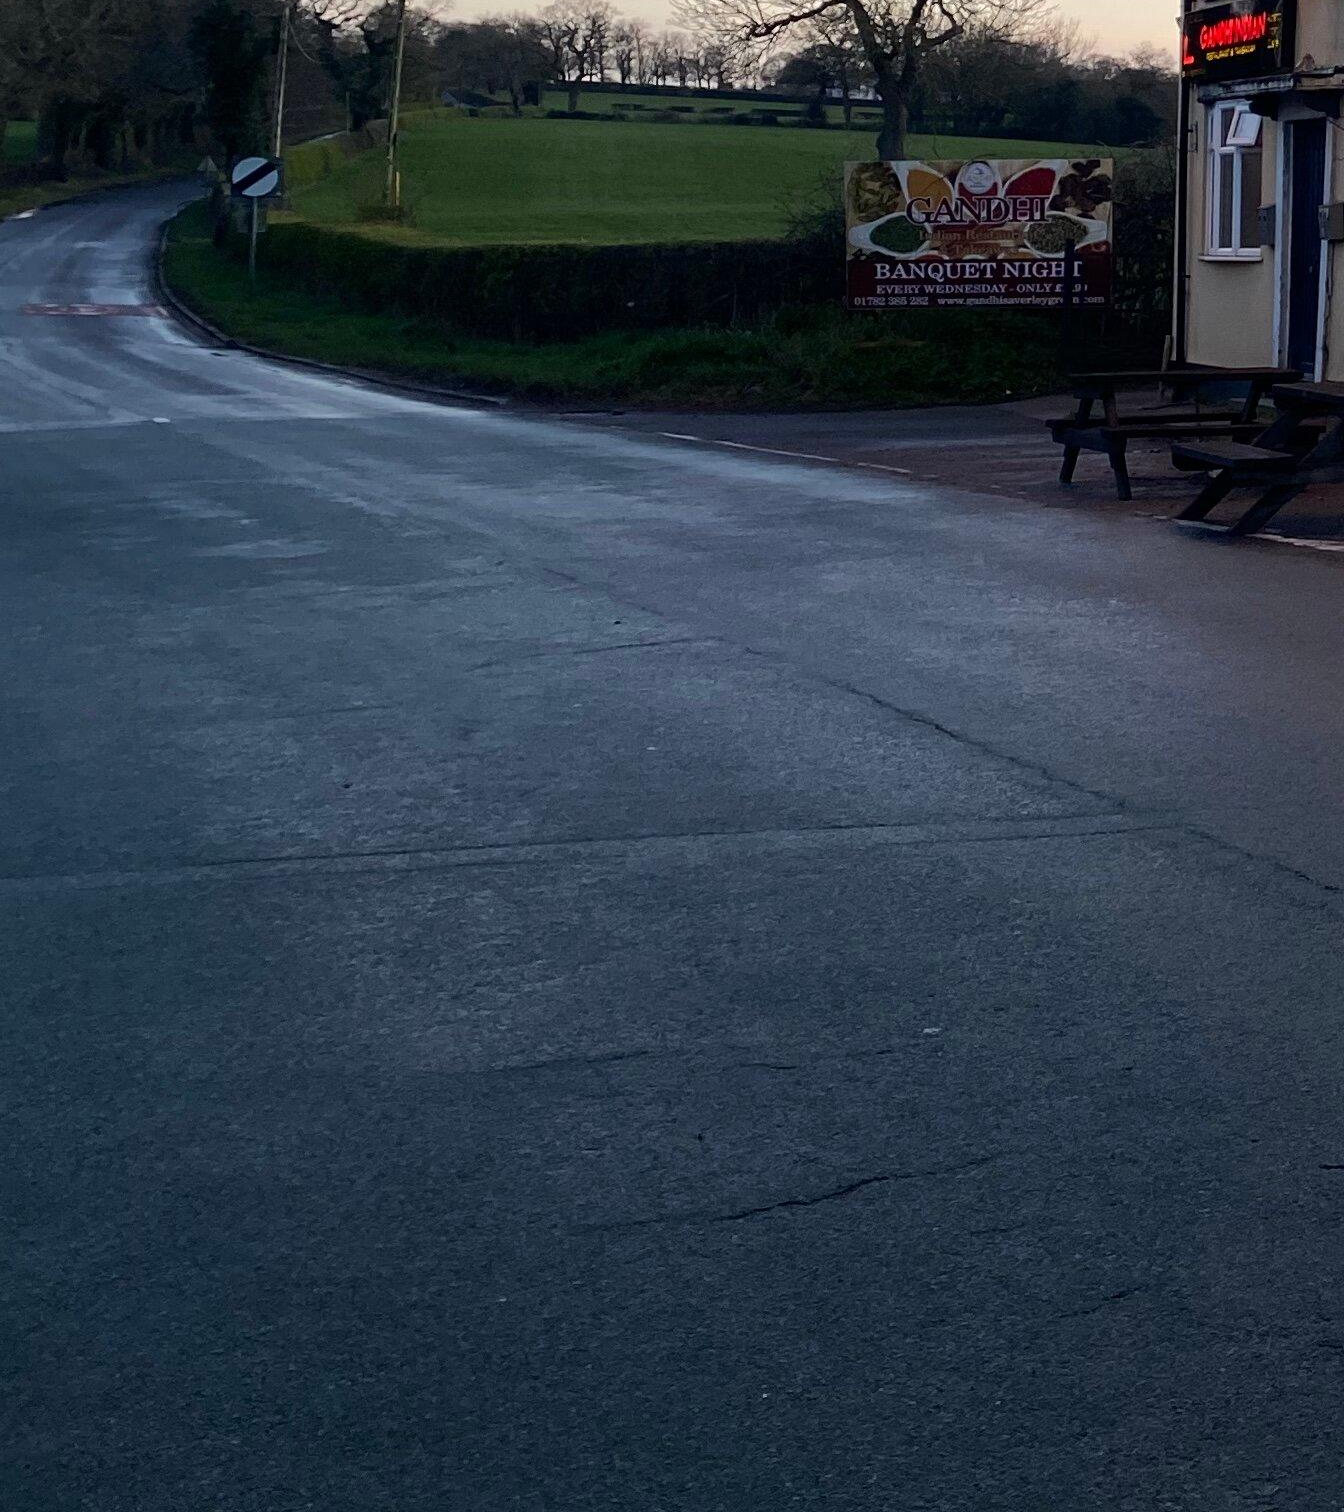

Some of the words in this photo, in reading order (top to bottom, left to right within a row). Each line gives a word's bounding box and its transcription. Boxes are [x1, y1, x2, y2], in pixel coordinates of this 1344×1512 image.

[905, 196, 1050, 225] GANDHI
[874, 261, 997, 283] BANQUET
[1002, 261, 1083, 278] NIGHT
[876, 284, 922, 295] EVERY
[923, 283, 1008, 295] WEDNESDAY
[1016, 283, 1053, 293] ONLY
